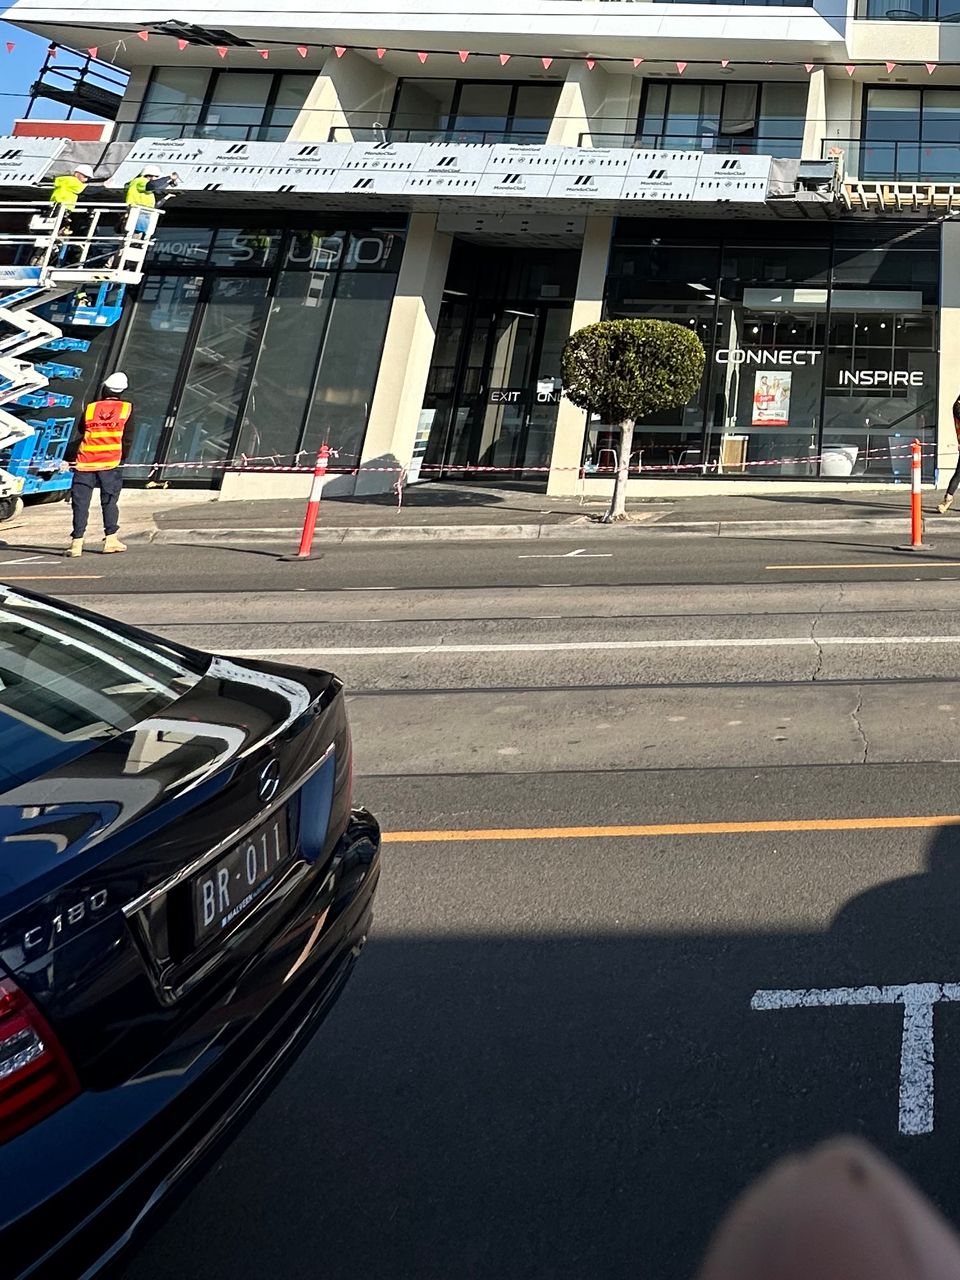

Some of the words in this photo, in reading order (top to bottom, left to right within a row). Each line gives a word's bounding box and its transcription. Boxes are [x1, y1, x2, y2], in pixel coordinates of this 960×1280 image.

[715, 349, 822, 365] CONNECT
[838, 370, 924, 386] INSPIRE
[491, 392, 521, 402] EXIT
[537, 392, 560, 402] ONL
